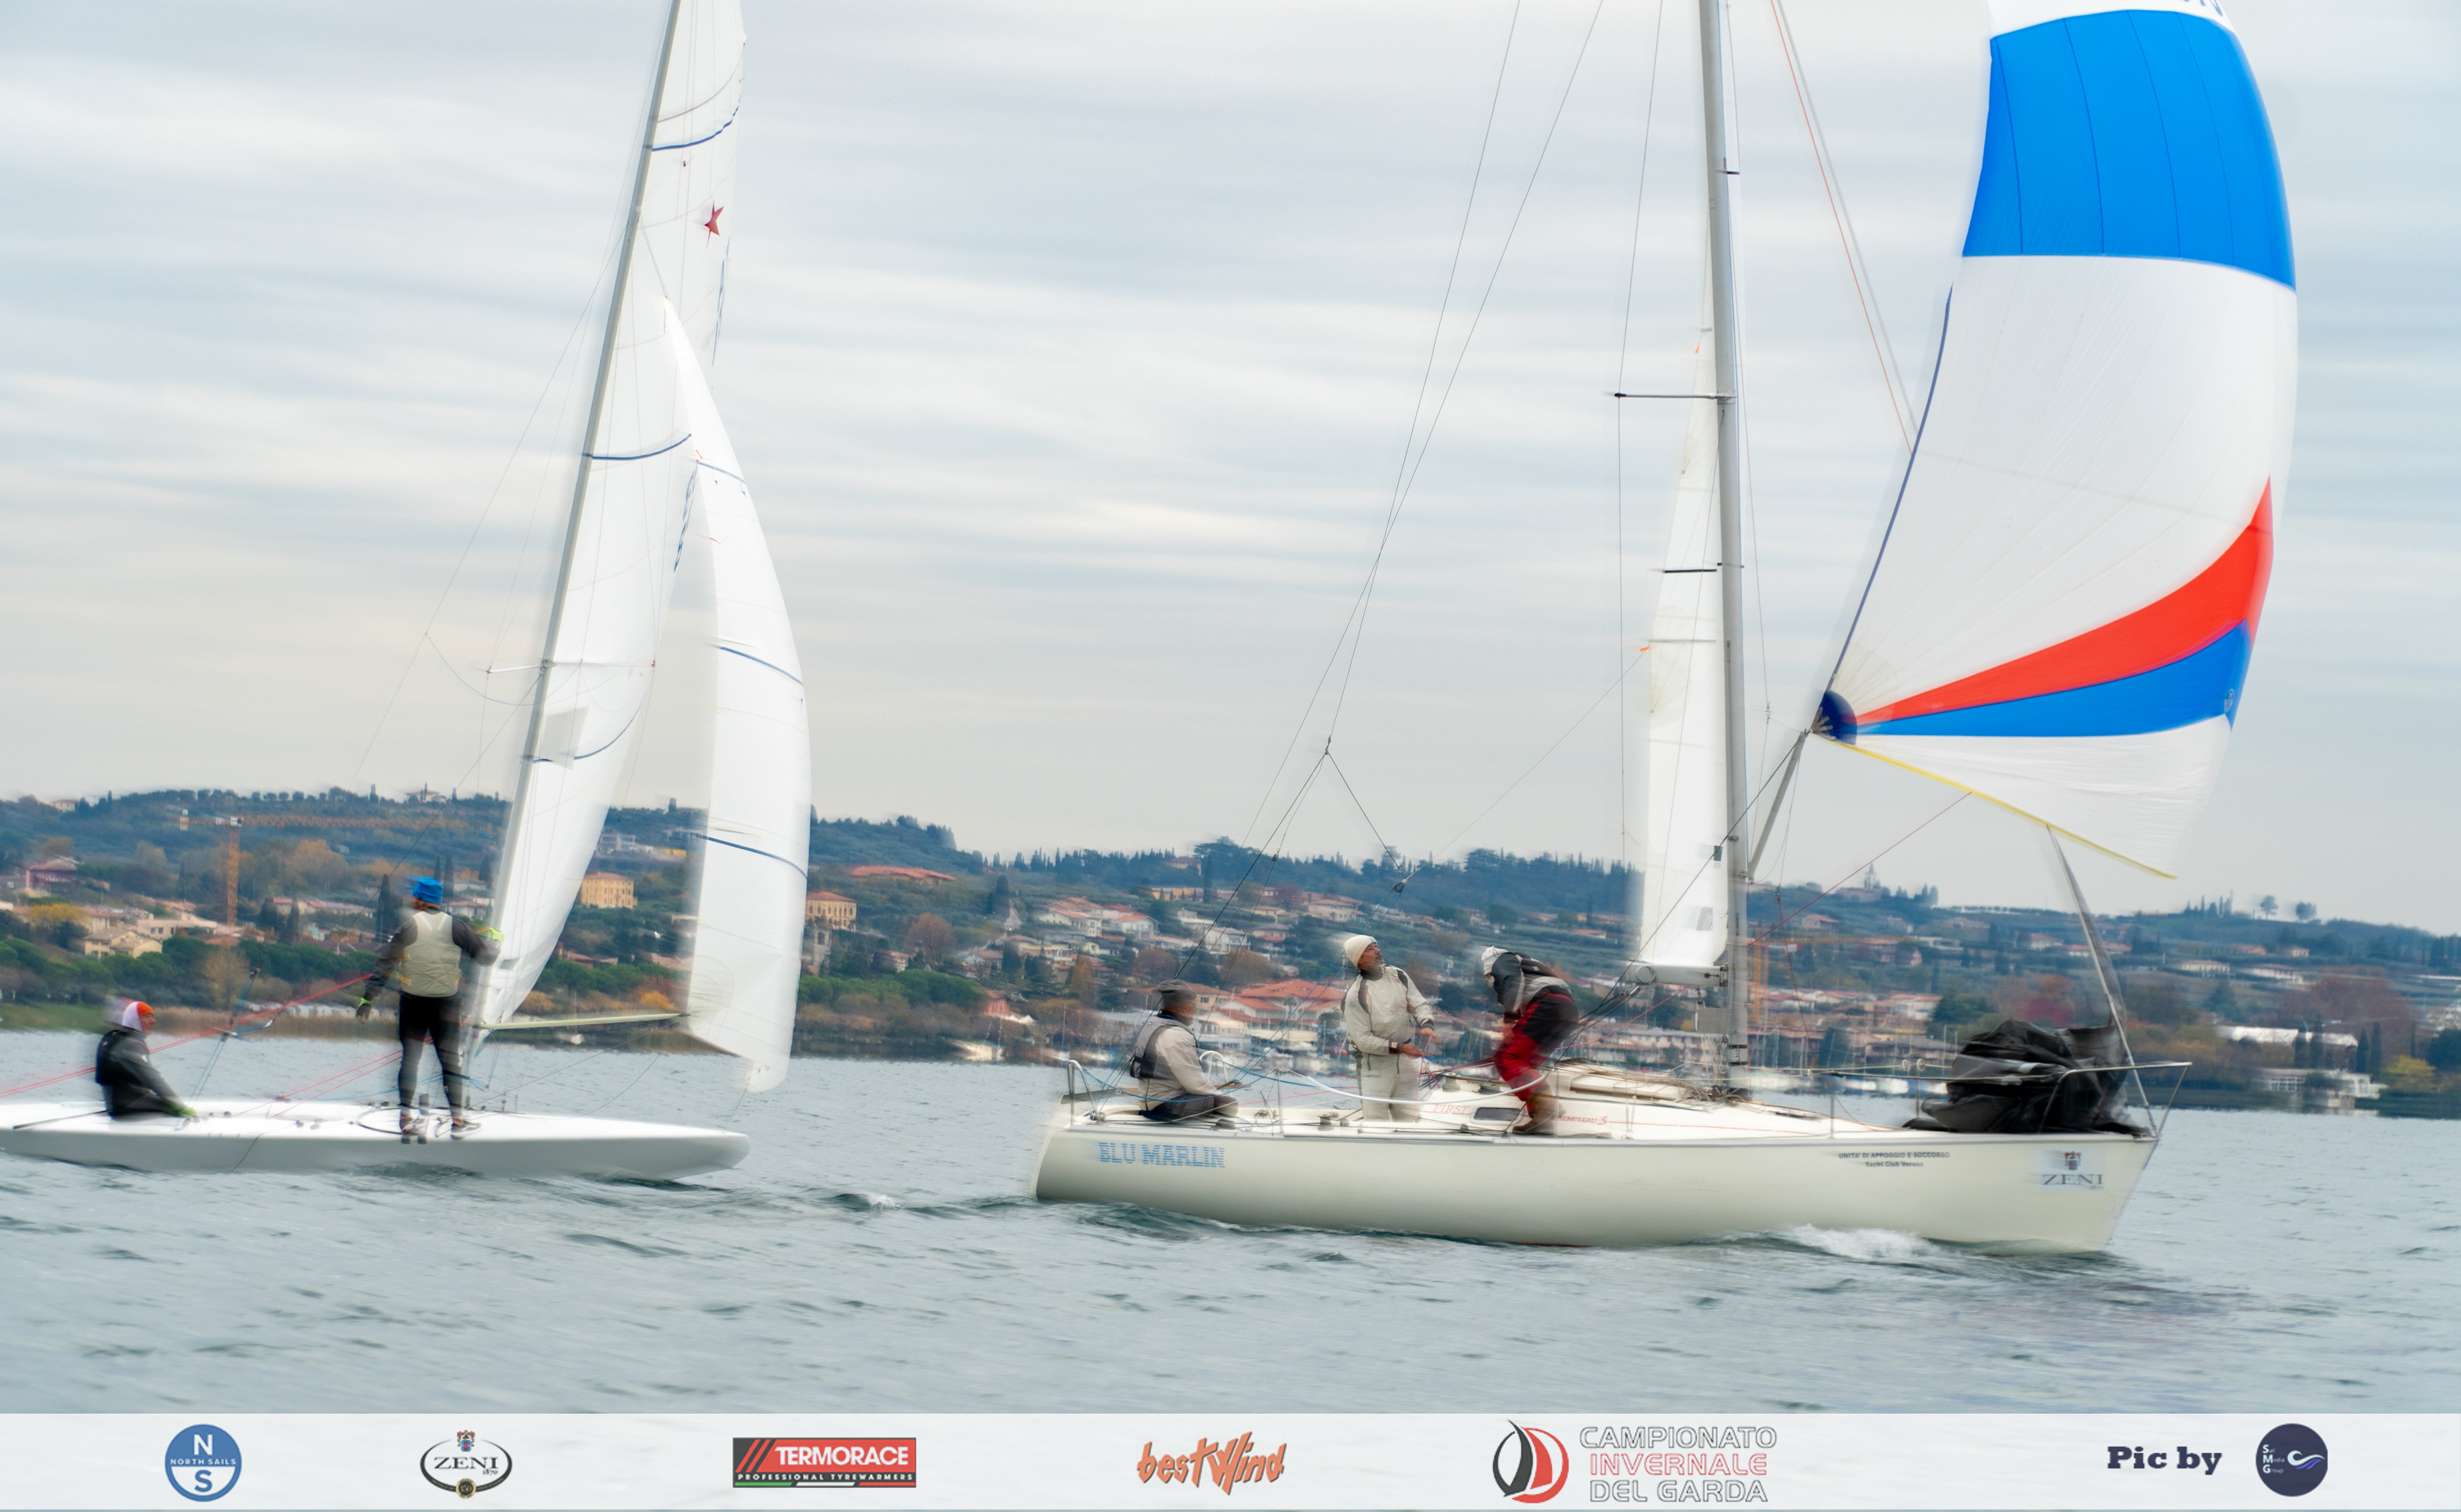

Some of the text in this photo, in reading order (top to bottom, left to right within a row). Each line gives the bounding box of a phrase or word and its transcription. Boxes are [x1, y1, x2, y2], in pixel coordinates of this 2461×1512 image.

[1433, 1104, 1470, 1113] FIRST
[1098, 1142, 1225, 1168] BLU MARLIN
[2043, 1174, 2103, 1185] ZENI
